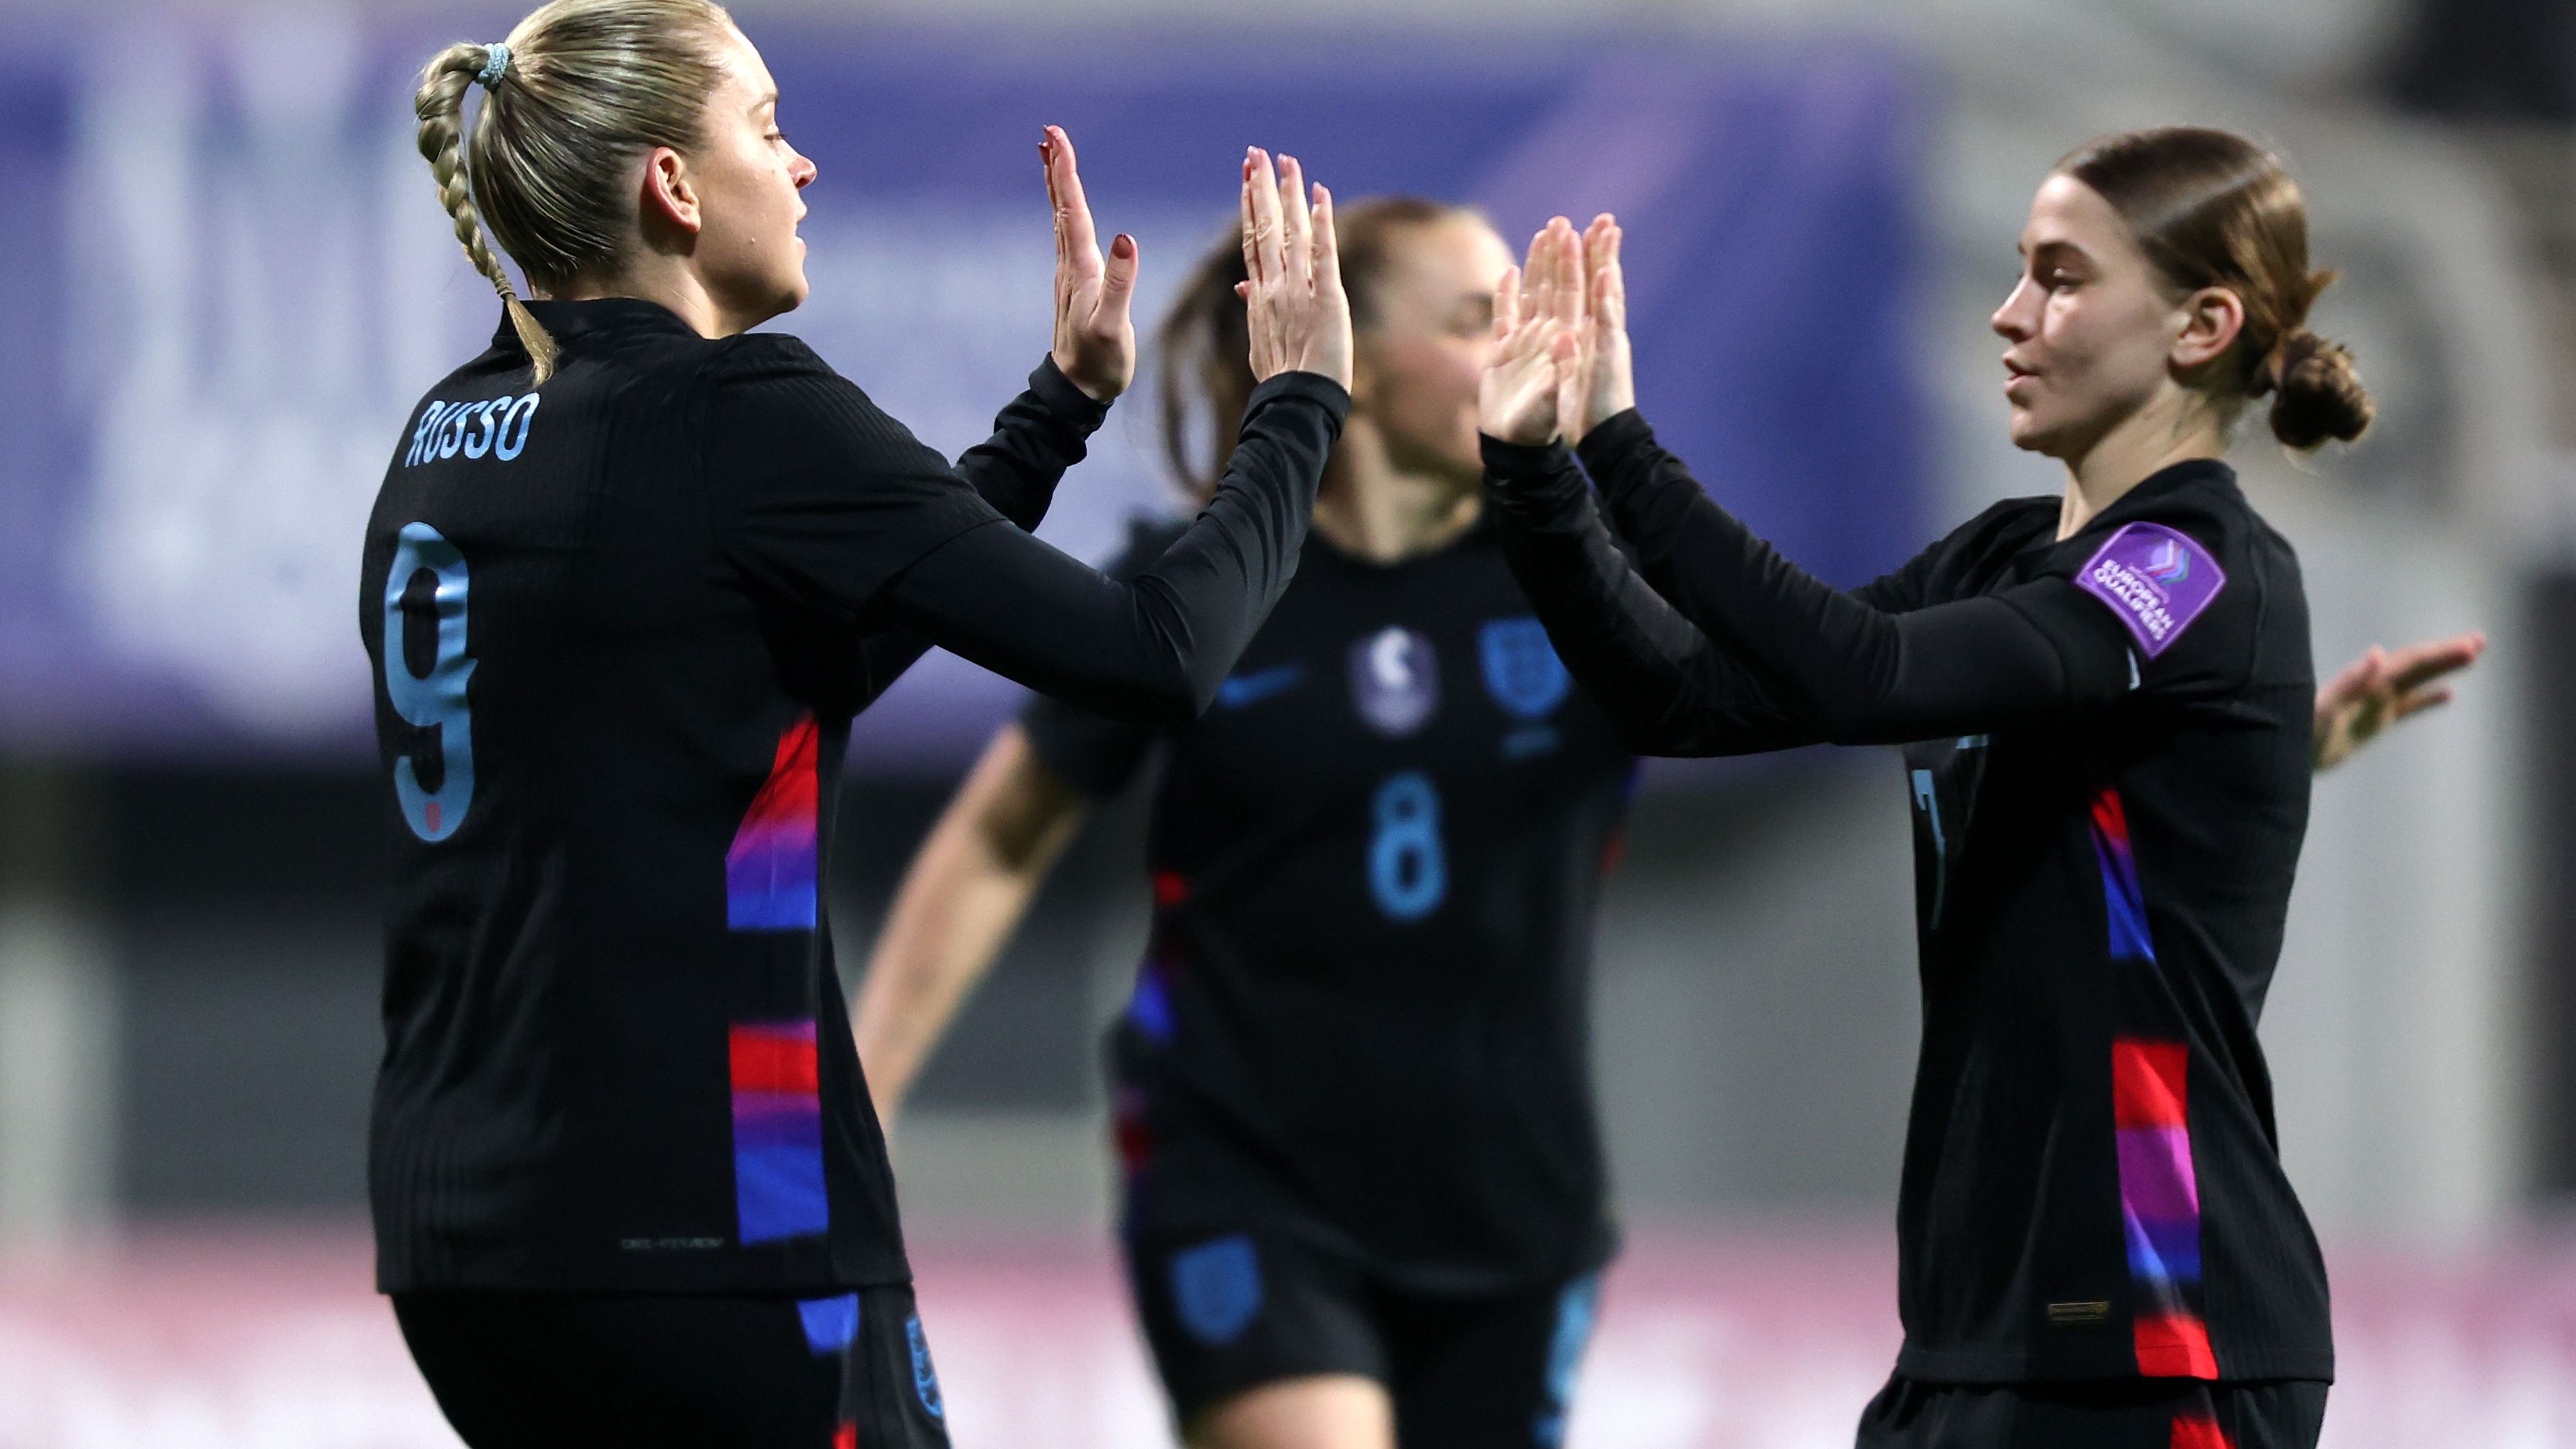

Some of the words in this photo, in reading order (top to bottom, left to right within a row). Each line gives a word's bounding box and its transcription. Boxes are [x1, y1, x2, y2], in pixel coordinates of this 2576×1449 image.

[405, 392, 540, 468] RUSSO
[2102, 559, 2175, 630] EUROPEAN
[383, 521, 478, 842] 9
[1369, 770, 1447, 920] 8
